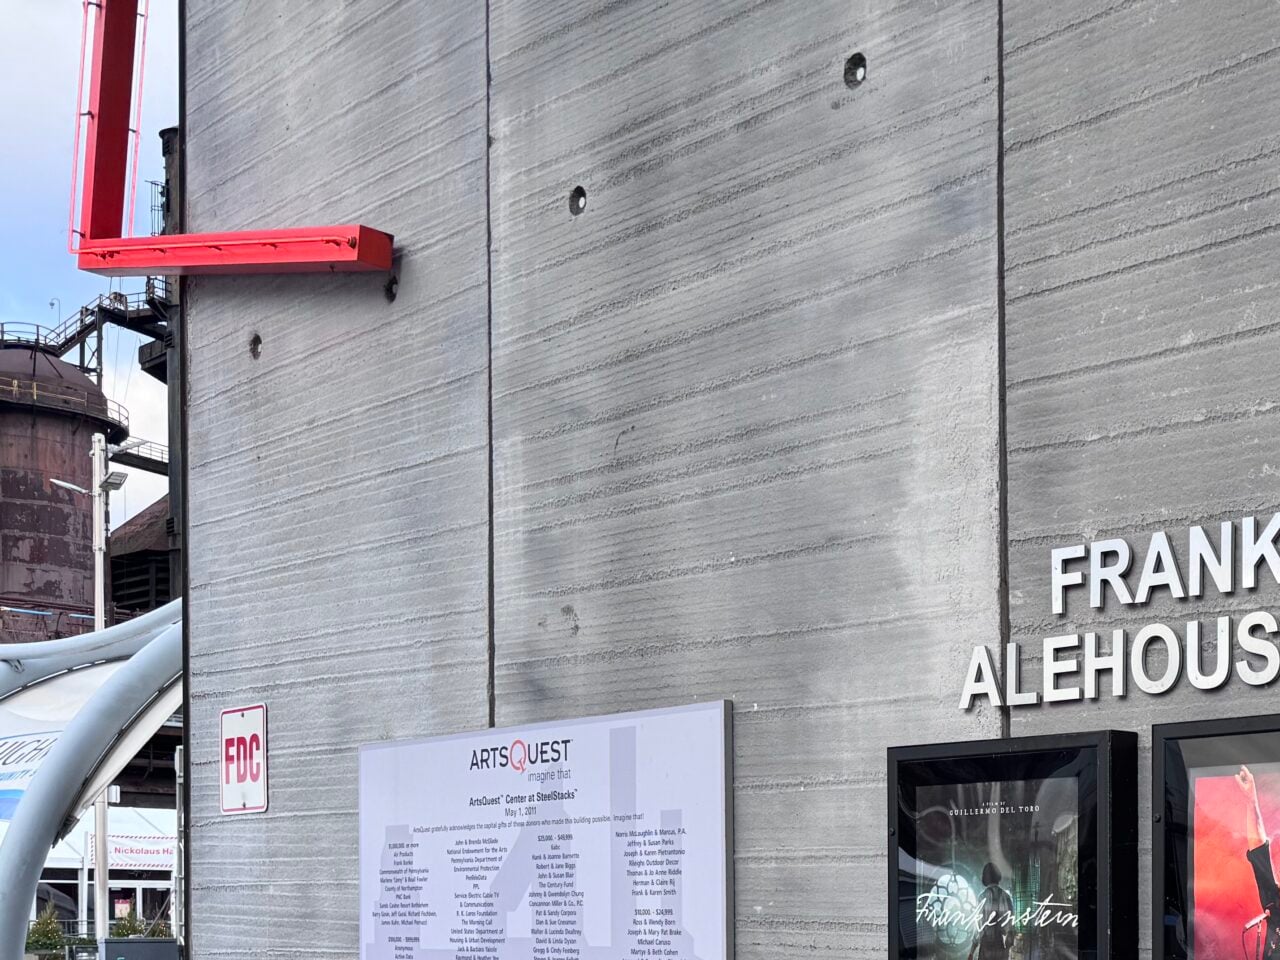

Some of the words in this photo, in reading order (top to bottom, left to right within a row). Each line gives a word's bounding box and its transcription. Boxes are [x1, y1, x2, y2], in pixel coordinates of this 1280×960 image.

[225, 733, 260, 785] FDC
[470, 739, 572, 774] ARTSQUEST
[528, 770, 555, 783] imagine
[557, 768, 571, 779] that
[505, 794, 526, 804] Center
[528, 795, 535, 803] at
[505, 808, 516, 817] May
[525, 806, 537, 815] 2011
[949, 808, 997, 816] GUILLERMO
[1019, 805, 1040, 813] TORO
[114, 847, 160, 855] Nickolaus
[917, 892, 1078, 933] Frankenstein
